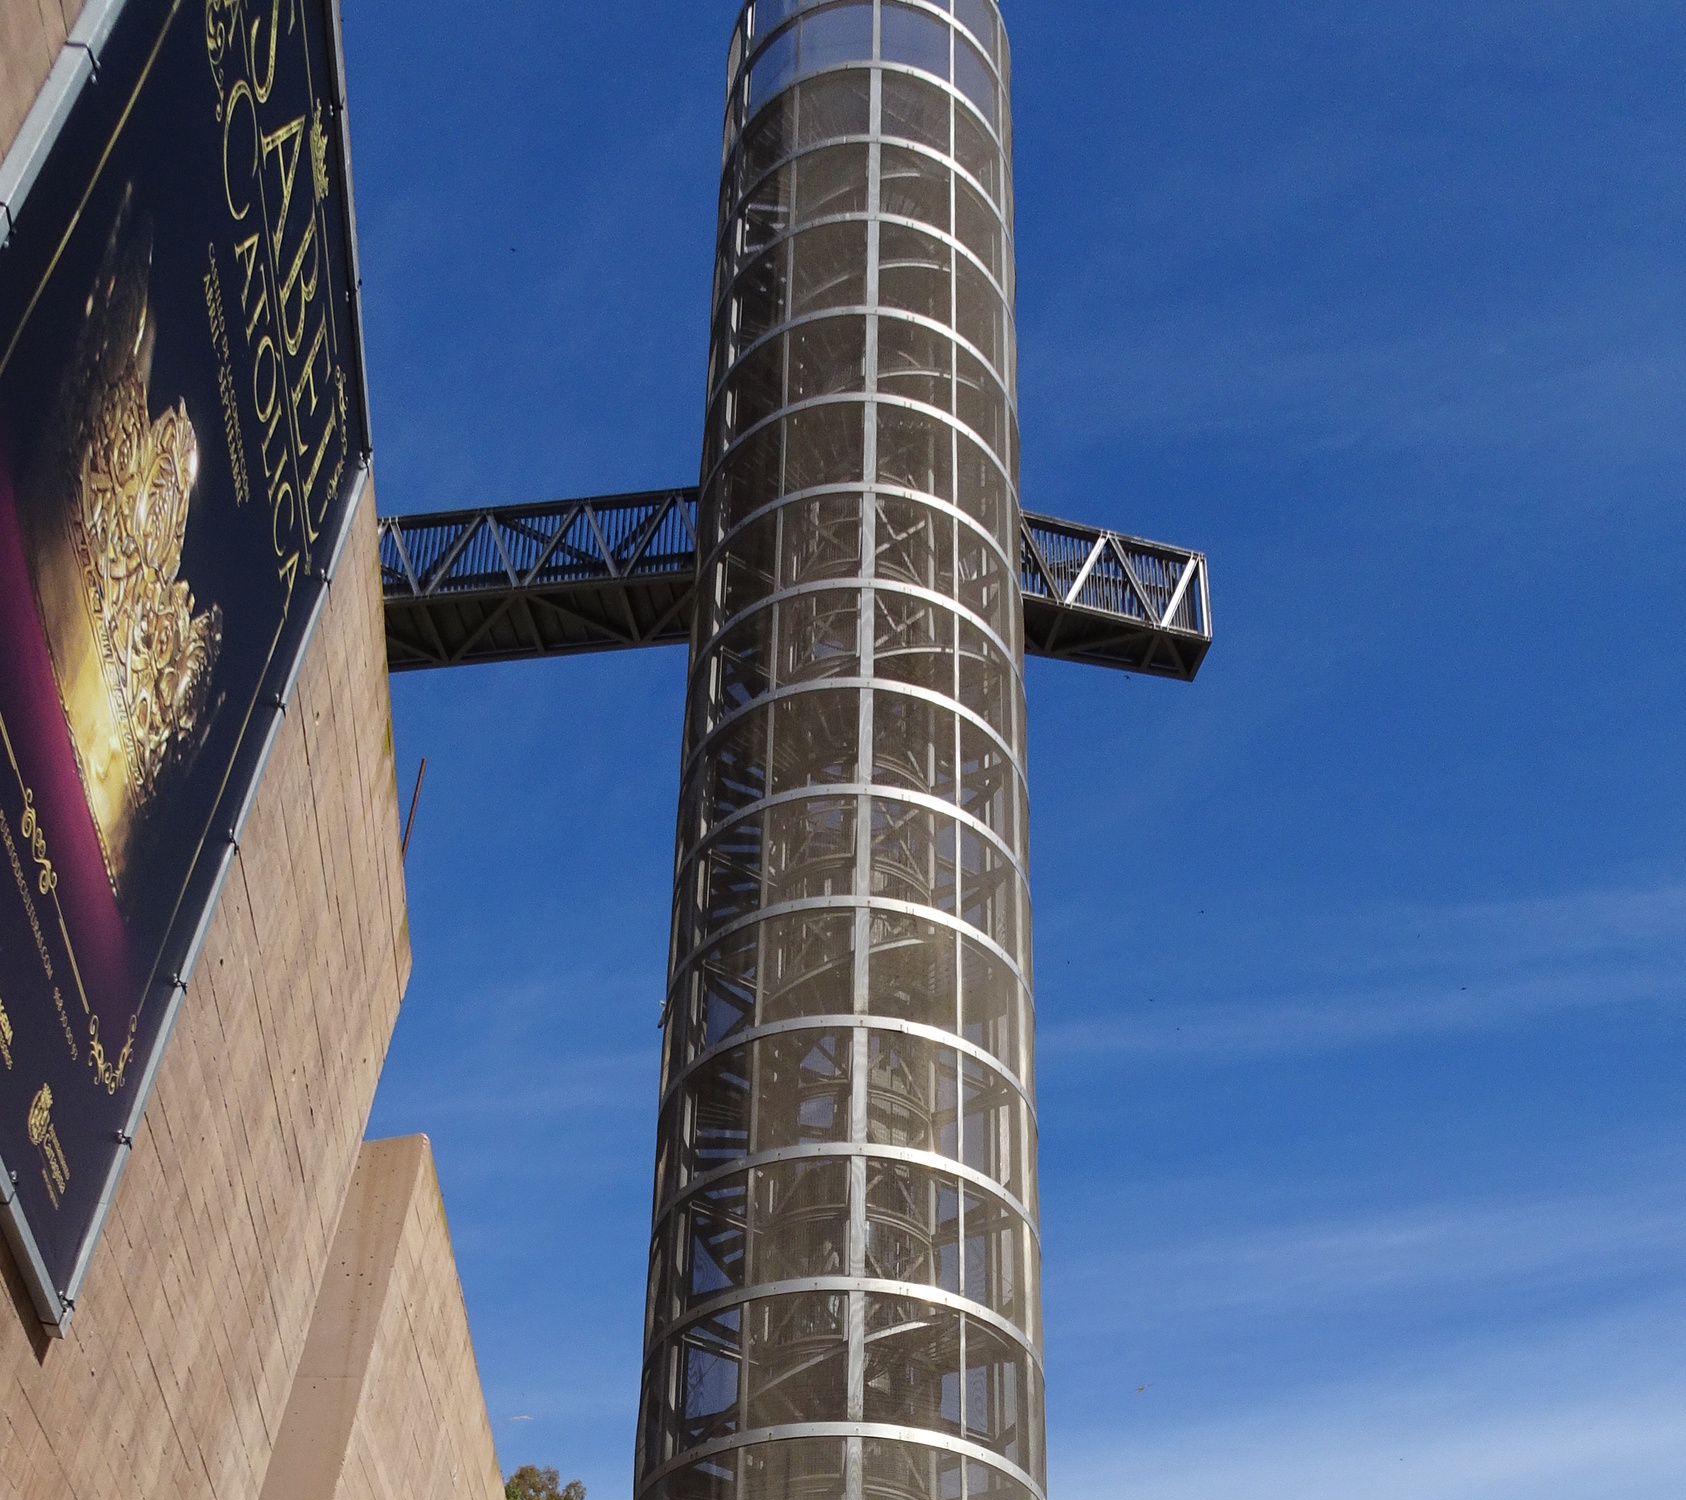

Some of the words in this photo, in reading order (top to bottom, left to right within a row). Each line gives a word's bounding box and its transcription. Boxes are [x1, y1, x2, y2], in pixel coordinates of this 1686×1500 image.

[203, 273, 219, 350] ABRIL
[218, 365, 244, 508] SEPTIEMBRE
[208, 241, 225, 333] CASTILLO
[221, 334, 230, 363] DE
[226, 364, 233, 389] LA
[223, 79, 300, 621] CATÓLICA
